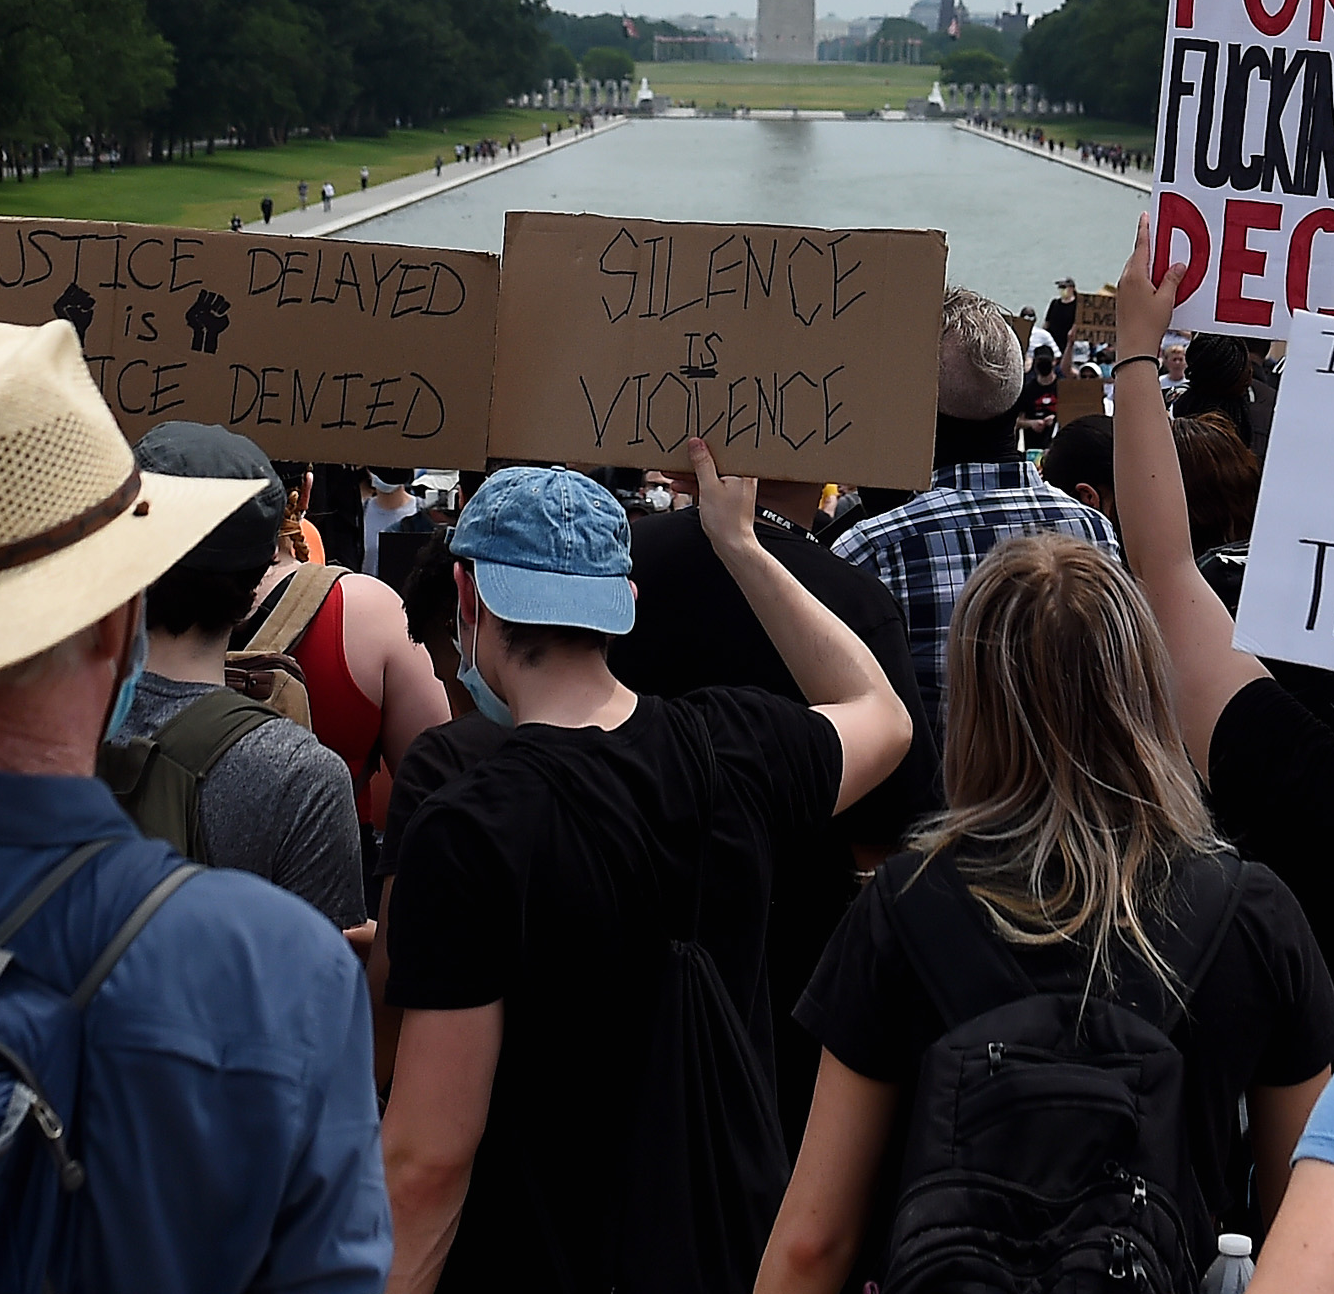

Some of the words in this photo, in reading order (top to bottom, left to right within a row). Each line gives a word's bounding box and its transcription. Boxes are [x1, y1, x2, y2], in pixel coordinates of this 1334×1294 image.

[246, 246, 468, 319] DELAYED
[599, 226, 867, 327] SILENCE
[679, 330, 724, 372] IS
[1082, 310, 1116, 327] LIVE
[228, 362, 445, 439] DENIED
[579, 364, 854, 454] VIOLENCE
[761, 509, 794, 530] IKEA
